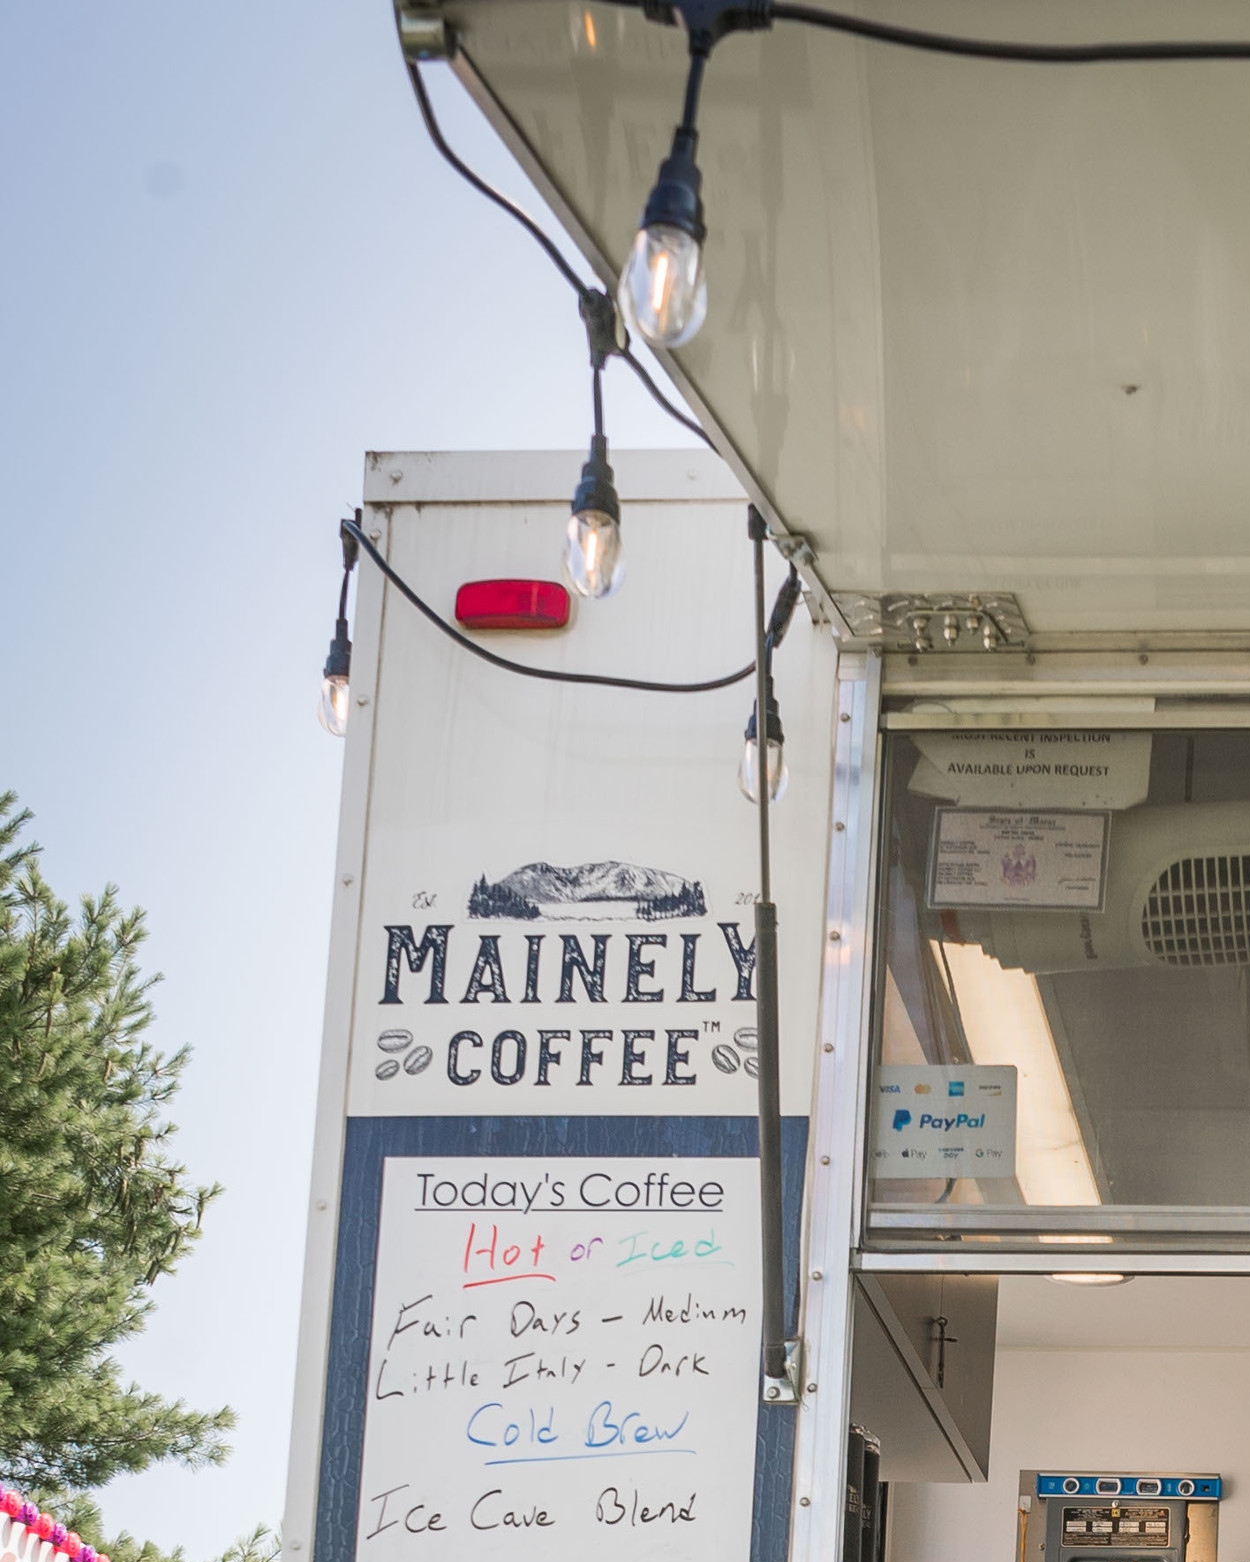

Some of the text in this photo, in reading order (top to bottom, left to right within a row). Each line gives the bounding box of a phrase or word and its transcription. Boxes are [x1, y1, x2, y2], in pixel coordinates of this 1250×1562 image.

[947, 763, 1110, 777] AVAILABLE UPON REQUEST
[1025, 749, 1035, 759] IS
[735, 892, 760, 905] 201
[378, 922, 757, 1004] MAINELY
[447, 1029, 699, 1086] COFFEE
[880, 1085, 900, 1093] VISA
[919, 1113, 985, 1132] PayPal
[416, 1173, 725, 1214] Today's Coffee
[463, 1223, 722, 1272] Hot or Iced
[387, 1294, 477, 1351] Fair
[510, 1300, 582, 1335] Days
[642, 1293, 746, 1326] Medium
[376, 1359, 480, 1400] Little
[503, 1352, 586, 1389] Italy
[638, 1344, 710, 1377] Dark
[467, 1401, 689, 1448] Cold Brew
[366, 1484, 697, 1540] Ice Cave Blend
